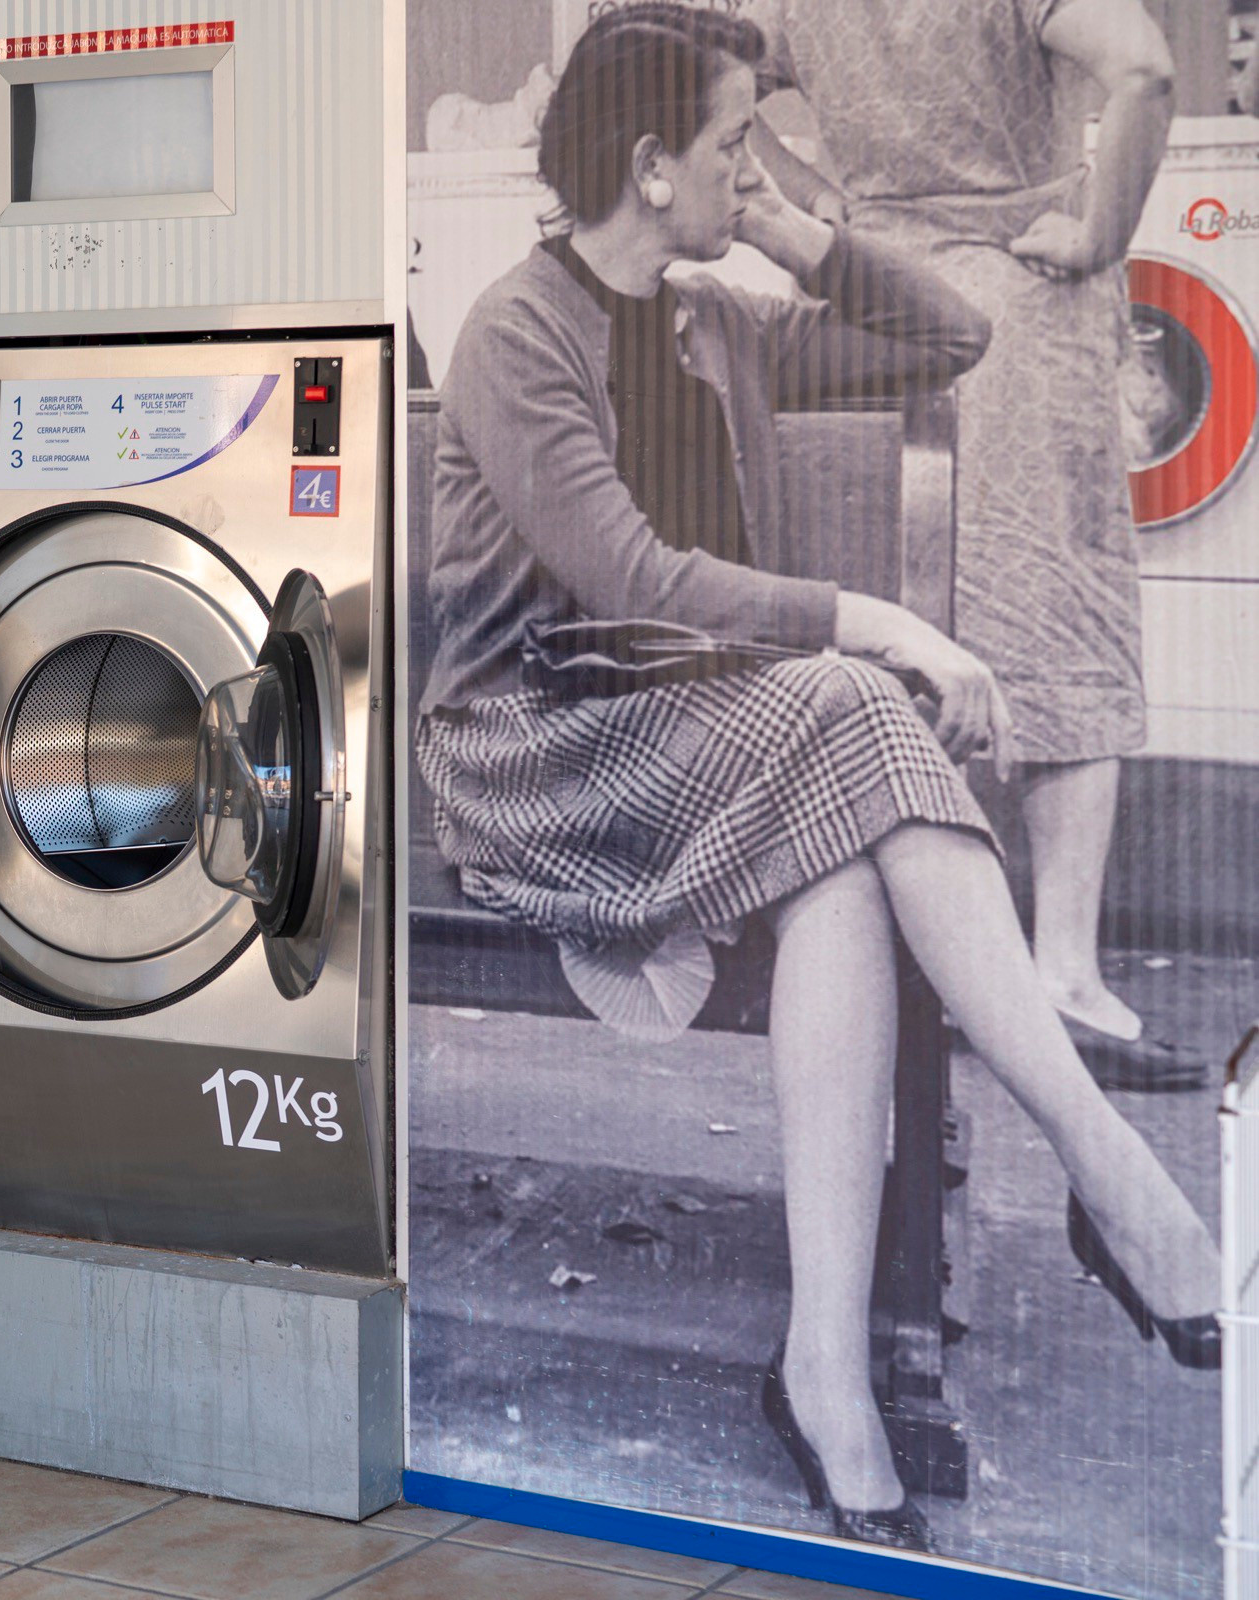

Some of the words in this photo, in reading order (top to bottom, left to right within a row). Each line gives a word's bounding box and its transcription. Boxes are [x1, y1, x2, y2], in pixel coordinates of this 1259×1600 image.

[105, 36, 114, 46] LA
[160, 32, 170, 41] ES
[173, 27, 229, 40] AUTOMATICA
[1179, 213, 1202, 233] La
[13, 395, 21, 416] 1
[59, 395, 83, 403] PUERTA
[111, 394, 125, 414] 4
[134, 393, 164, 401] INSERTAR
[165, 392, 194, 400] IMPORTE
[141, 401, 163, 409] PULSE
[164, 400, 187, 409] START
[12, 420, 23, 440] 2
[62, 426, 86, 434] PUERTA
[10, 449, 23, 469] 3
[54, 454, 90, 462] PROGRAMA
[297, 472, 332, 509] 4€
[201, 1067, 343, 1153] 12Kg
